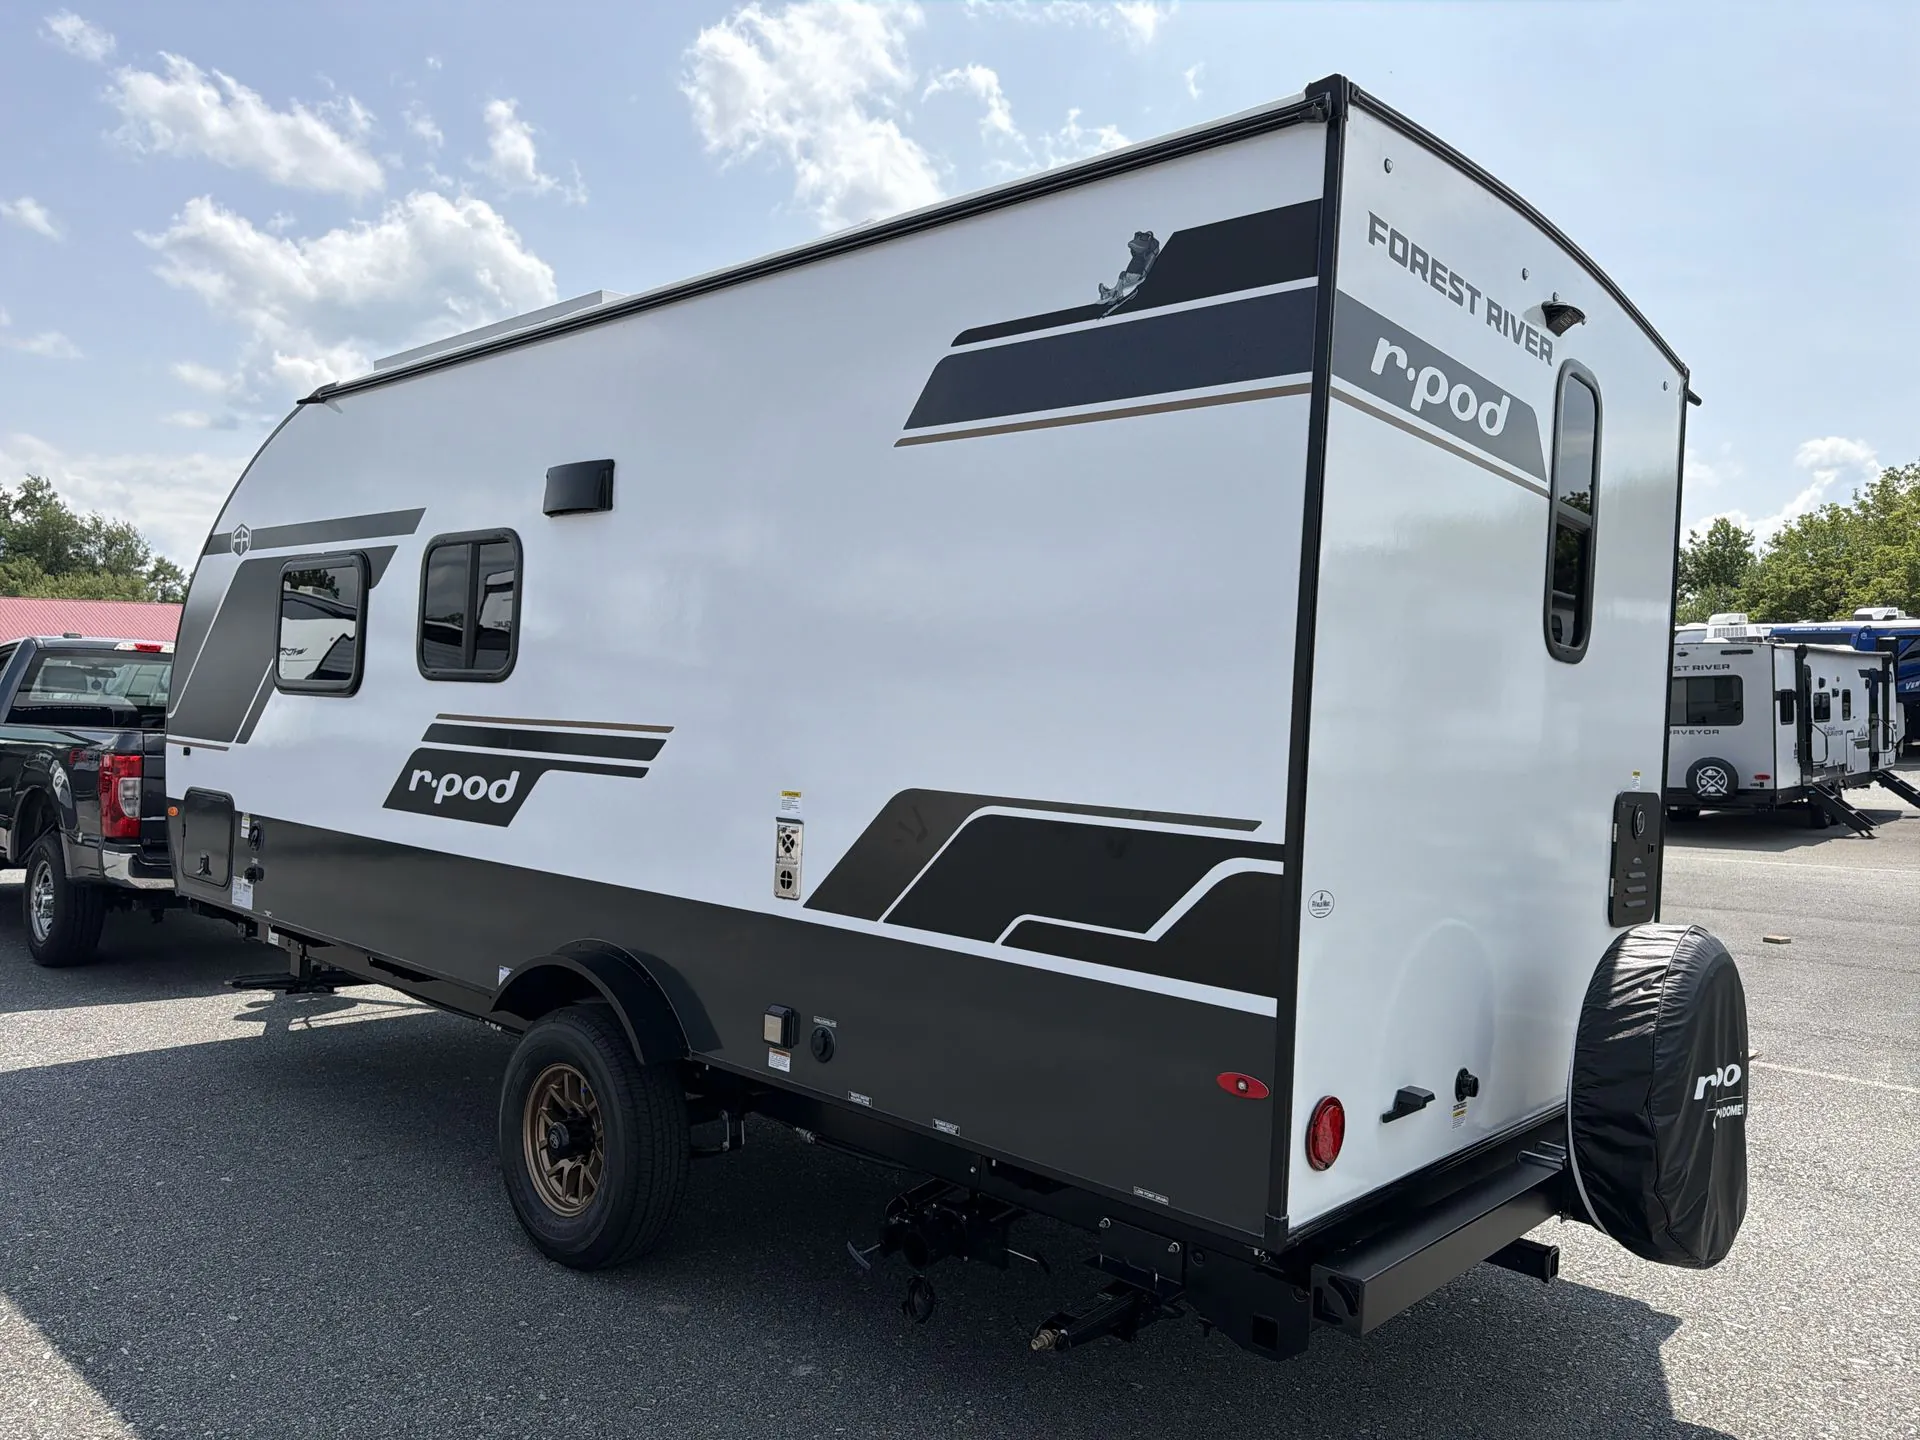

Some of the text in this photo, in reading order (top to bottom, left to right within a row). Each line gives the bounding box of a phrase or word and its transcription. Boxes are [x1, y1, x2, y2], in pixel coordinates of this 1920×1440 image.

[1368, 210, 1553, 366] FOREST RIVER
[1692, 663, 1731, 671] RIVER
